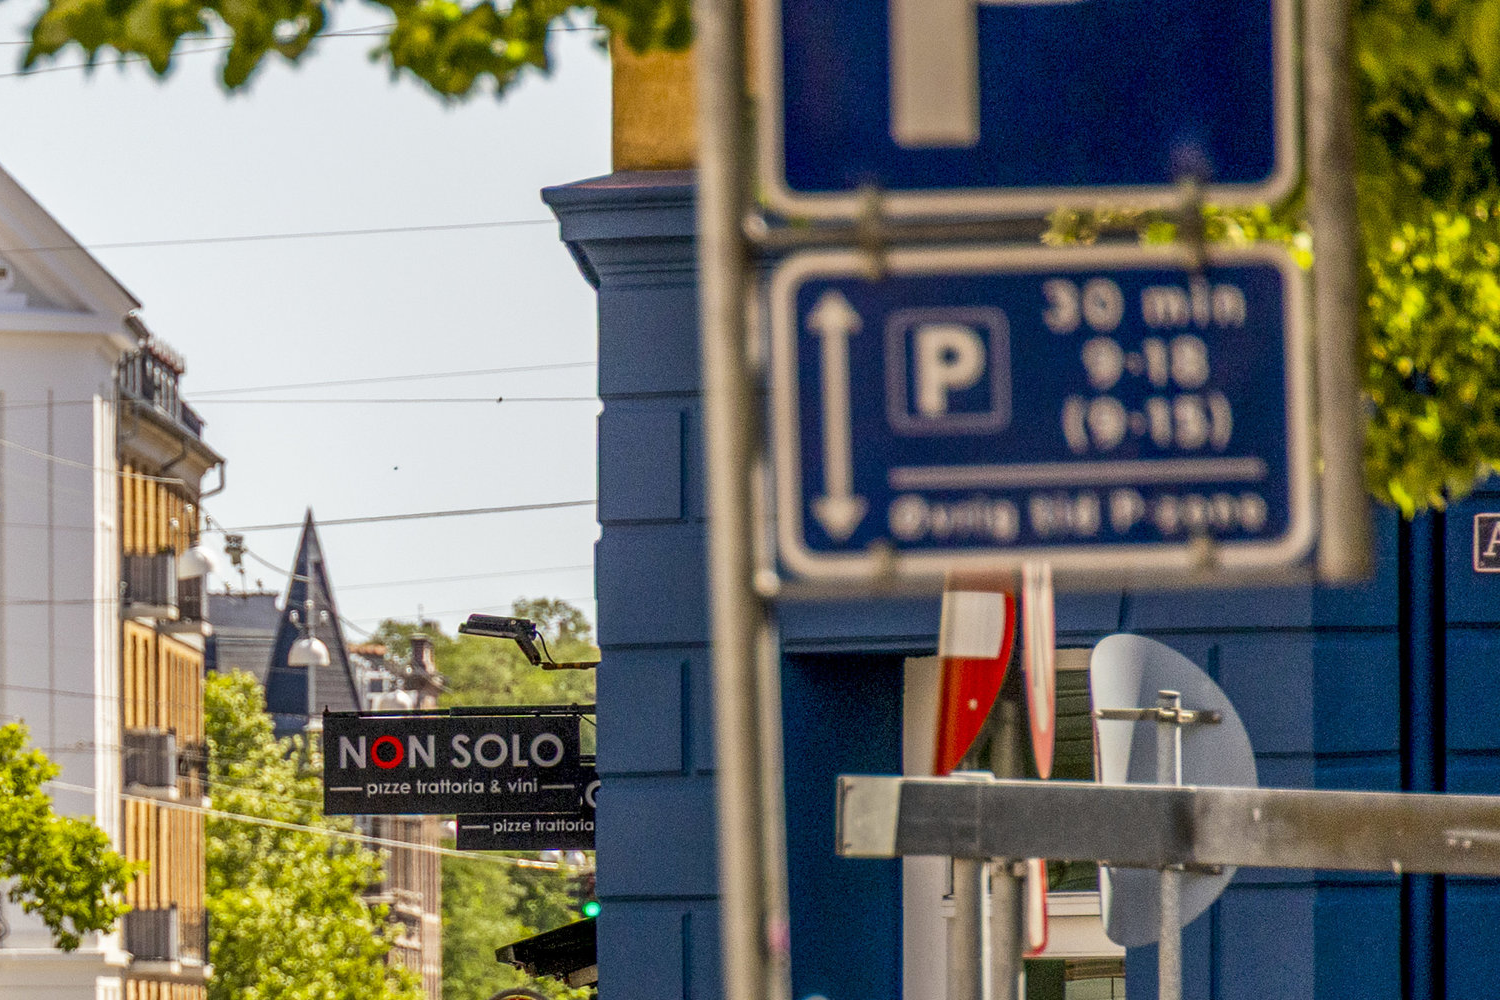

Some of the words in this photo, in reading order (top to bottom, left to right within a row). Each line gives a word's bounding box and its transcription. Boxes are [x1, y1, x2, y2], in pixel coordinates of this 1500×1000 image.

[1041, 278, 1124, 334] 30
[1140, 275, 1247, 329] min
[914, 322, 986, 418] P
[339, 734, 435, 769] NON
[450, 733, 564, 768] SOLO
[366, 782, 411, 797] pizze
[417, 779, 484, 795] trattoria
[490, 779, 501, 793] &
[508, 777, 538, 793] vini
[493, 819, 531, 834] pizze
[536, 817, 594, 831] trattoria
